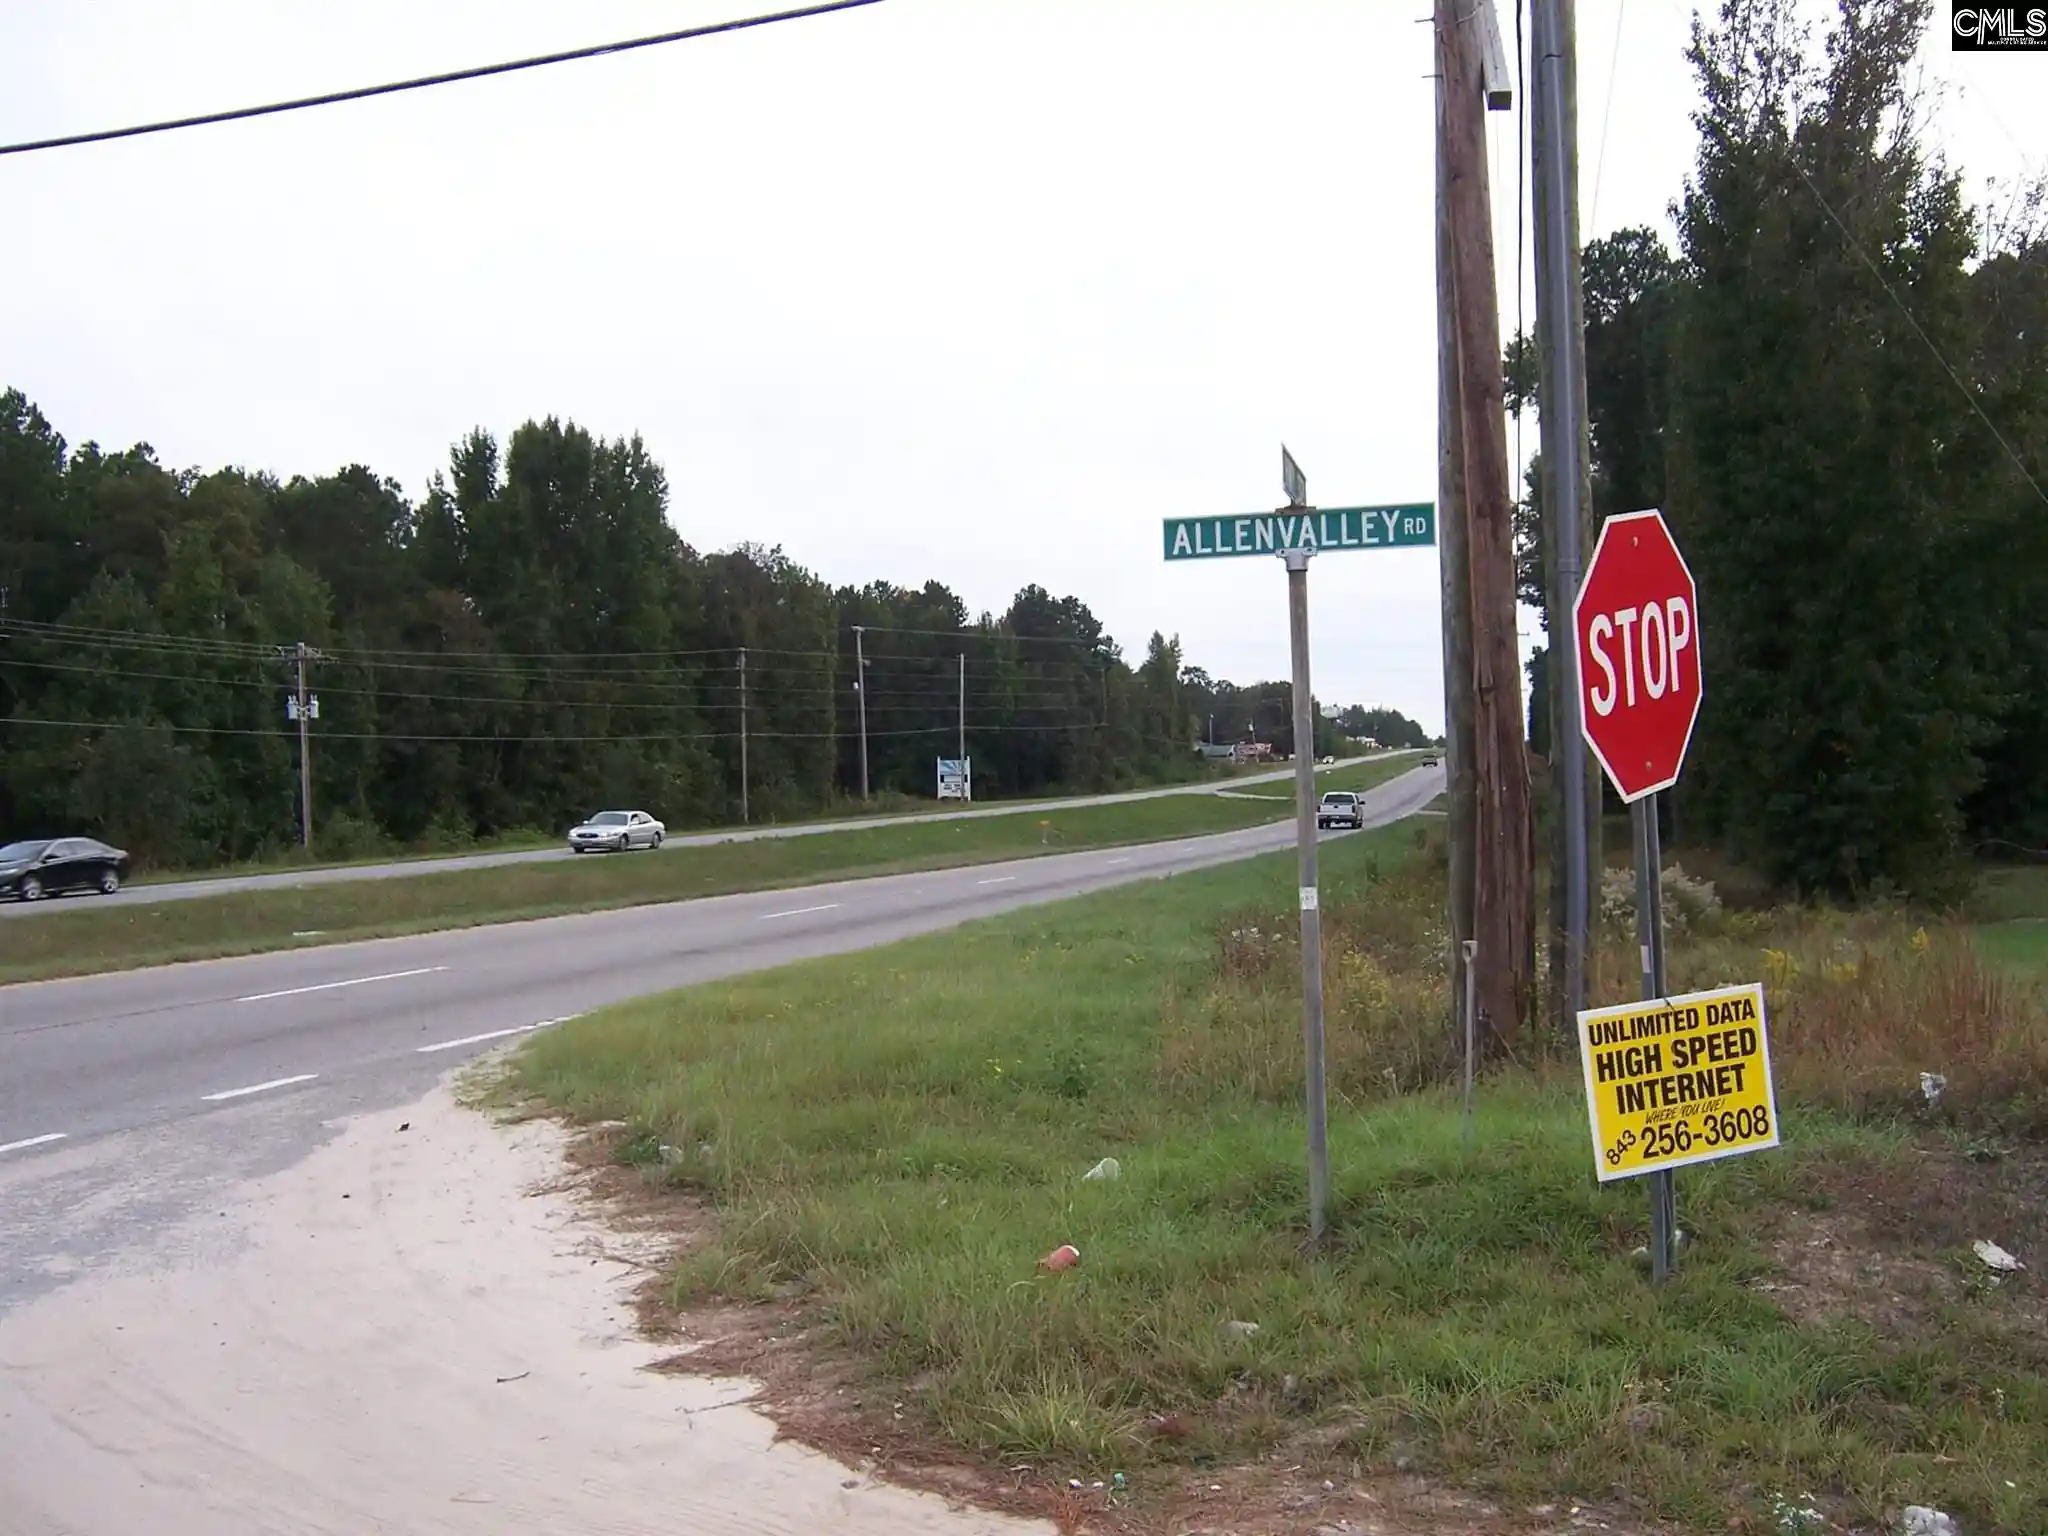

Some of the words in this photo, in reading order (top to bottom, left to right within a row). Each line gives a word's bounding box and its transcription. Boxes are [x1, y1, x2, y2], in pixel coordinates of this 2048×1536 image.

[1172, 510, 1401, 555] ALLENVALLEY
[1404, 516, 1426, 535] RD
[1589, 596, 1690, 717] STOP
[1588, 1007, 1700, 1047] UNLIMITED
[1706, 998, 1756, 1026] DATA
[1596, 1043, 1663, 1083] HIGH
[1670, 1027, 1757, 1069] SPEED
[1615, 1063, 1746, 1115] INTERNET
[1645, 1107, 1677, 1125] WHERE
[1681, 1104, 1700, 1117] YOU
[1606, 1129, 1637, 1166] 843
[1640, 1104, 1769, 1159] 256-3608
